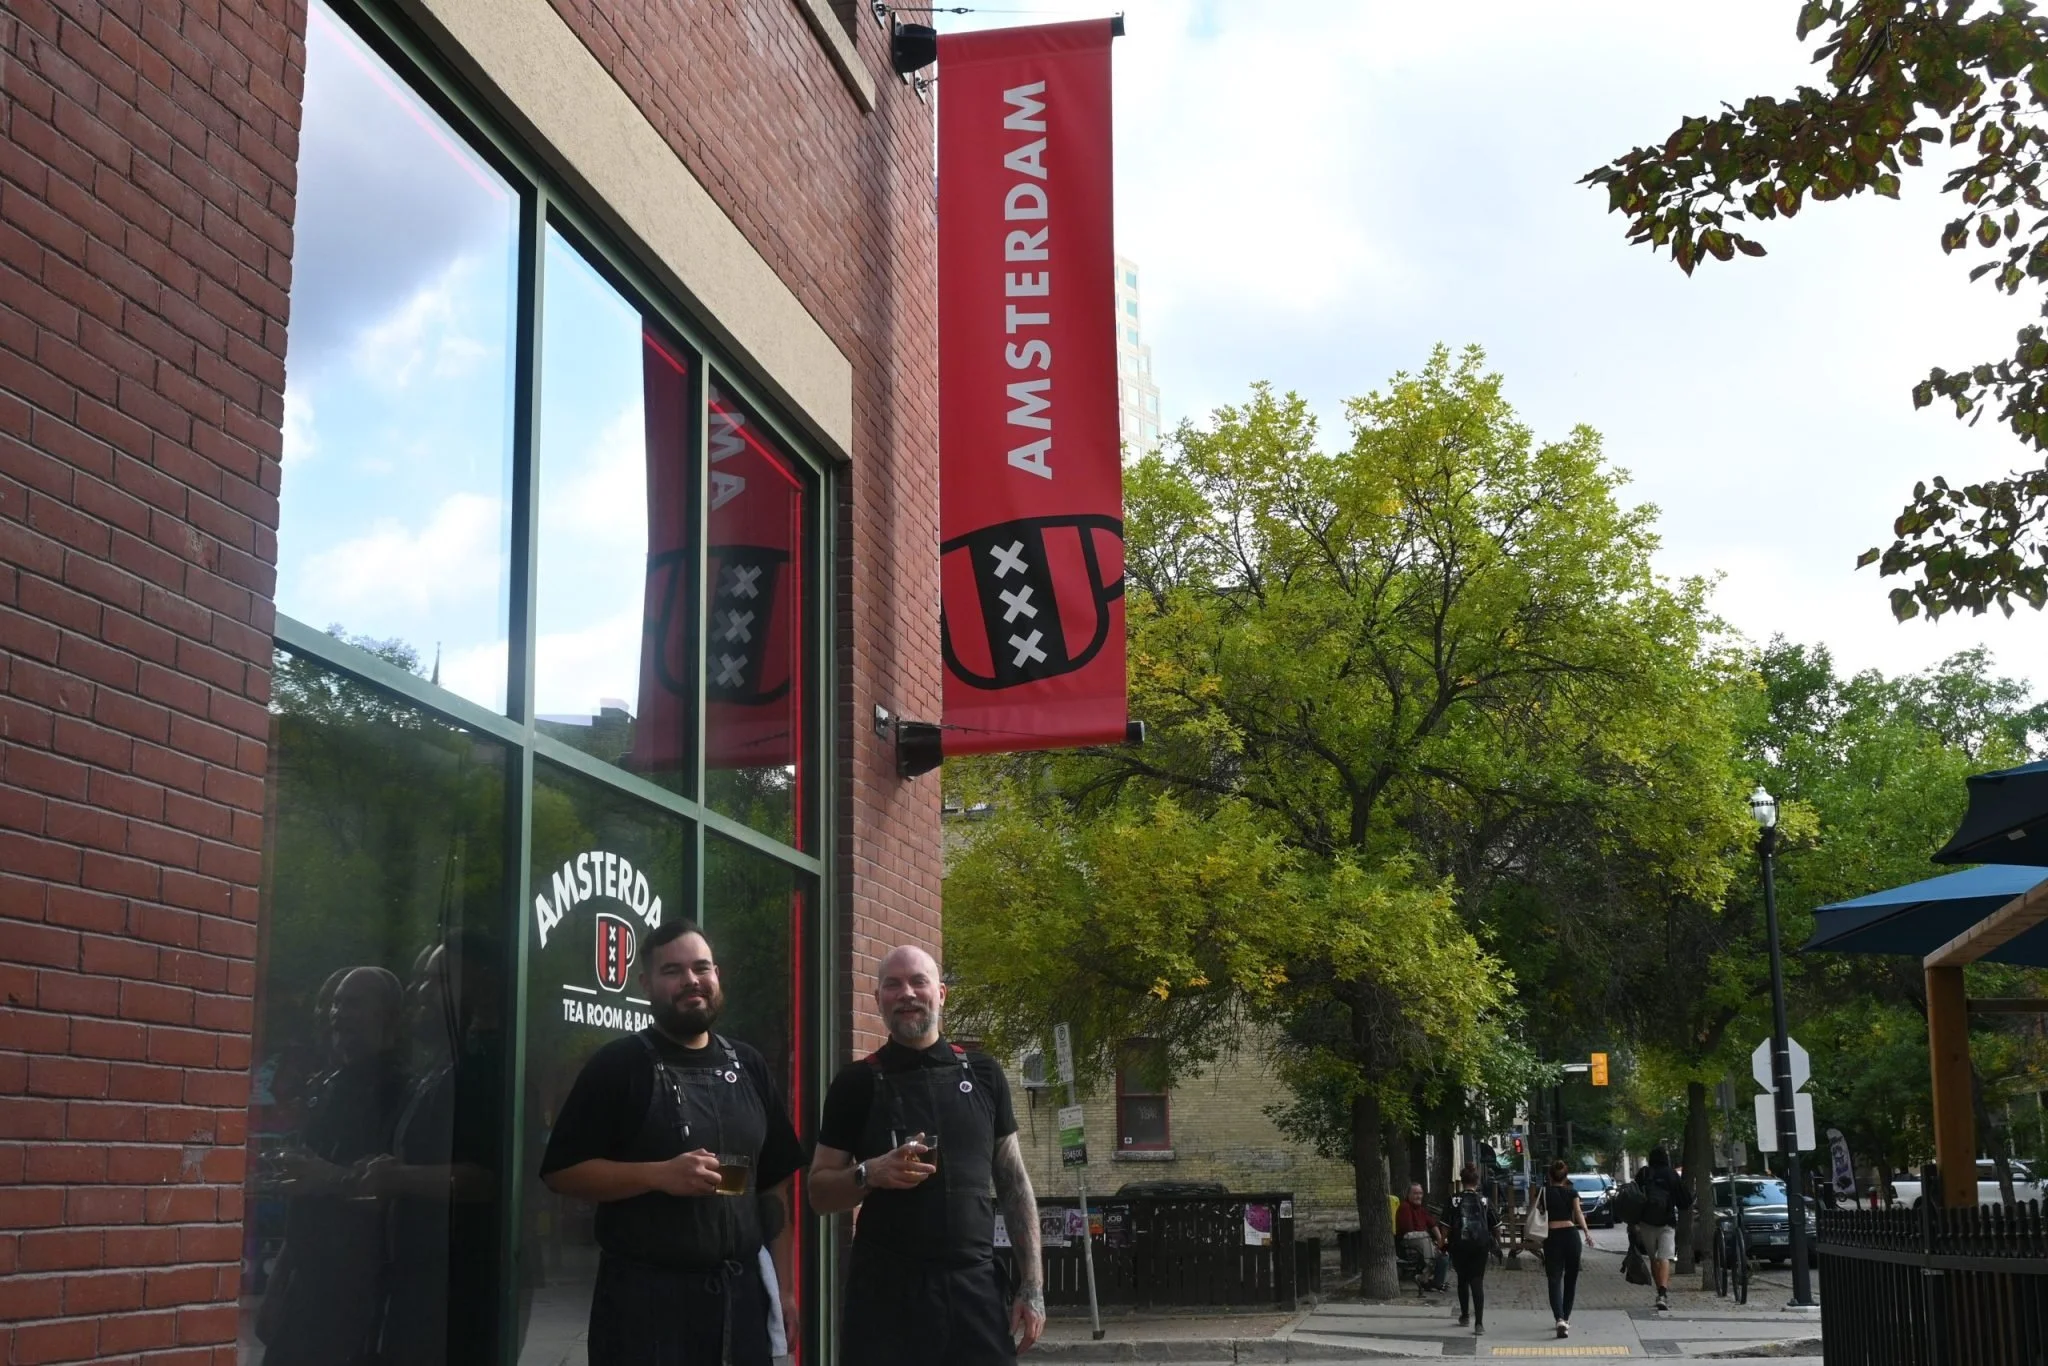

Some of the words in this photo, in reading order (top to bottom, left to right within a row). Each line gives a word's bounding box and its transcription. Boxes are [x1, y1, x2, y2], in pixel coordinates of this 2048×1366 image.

[1003, 80, 1053, 480] AMSTERDAM
[535, 851, 662, 950] AMSTERDA
[563, 998, 584, 1023] TEA
[587, 1003, 623, 1030] ROOM
[624, 1010, 633, 1031] &
